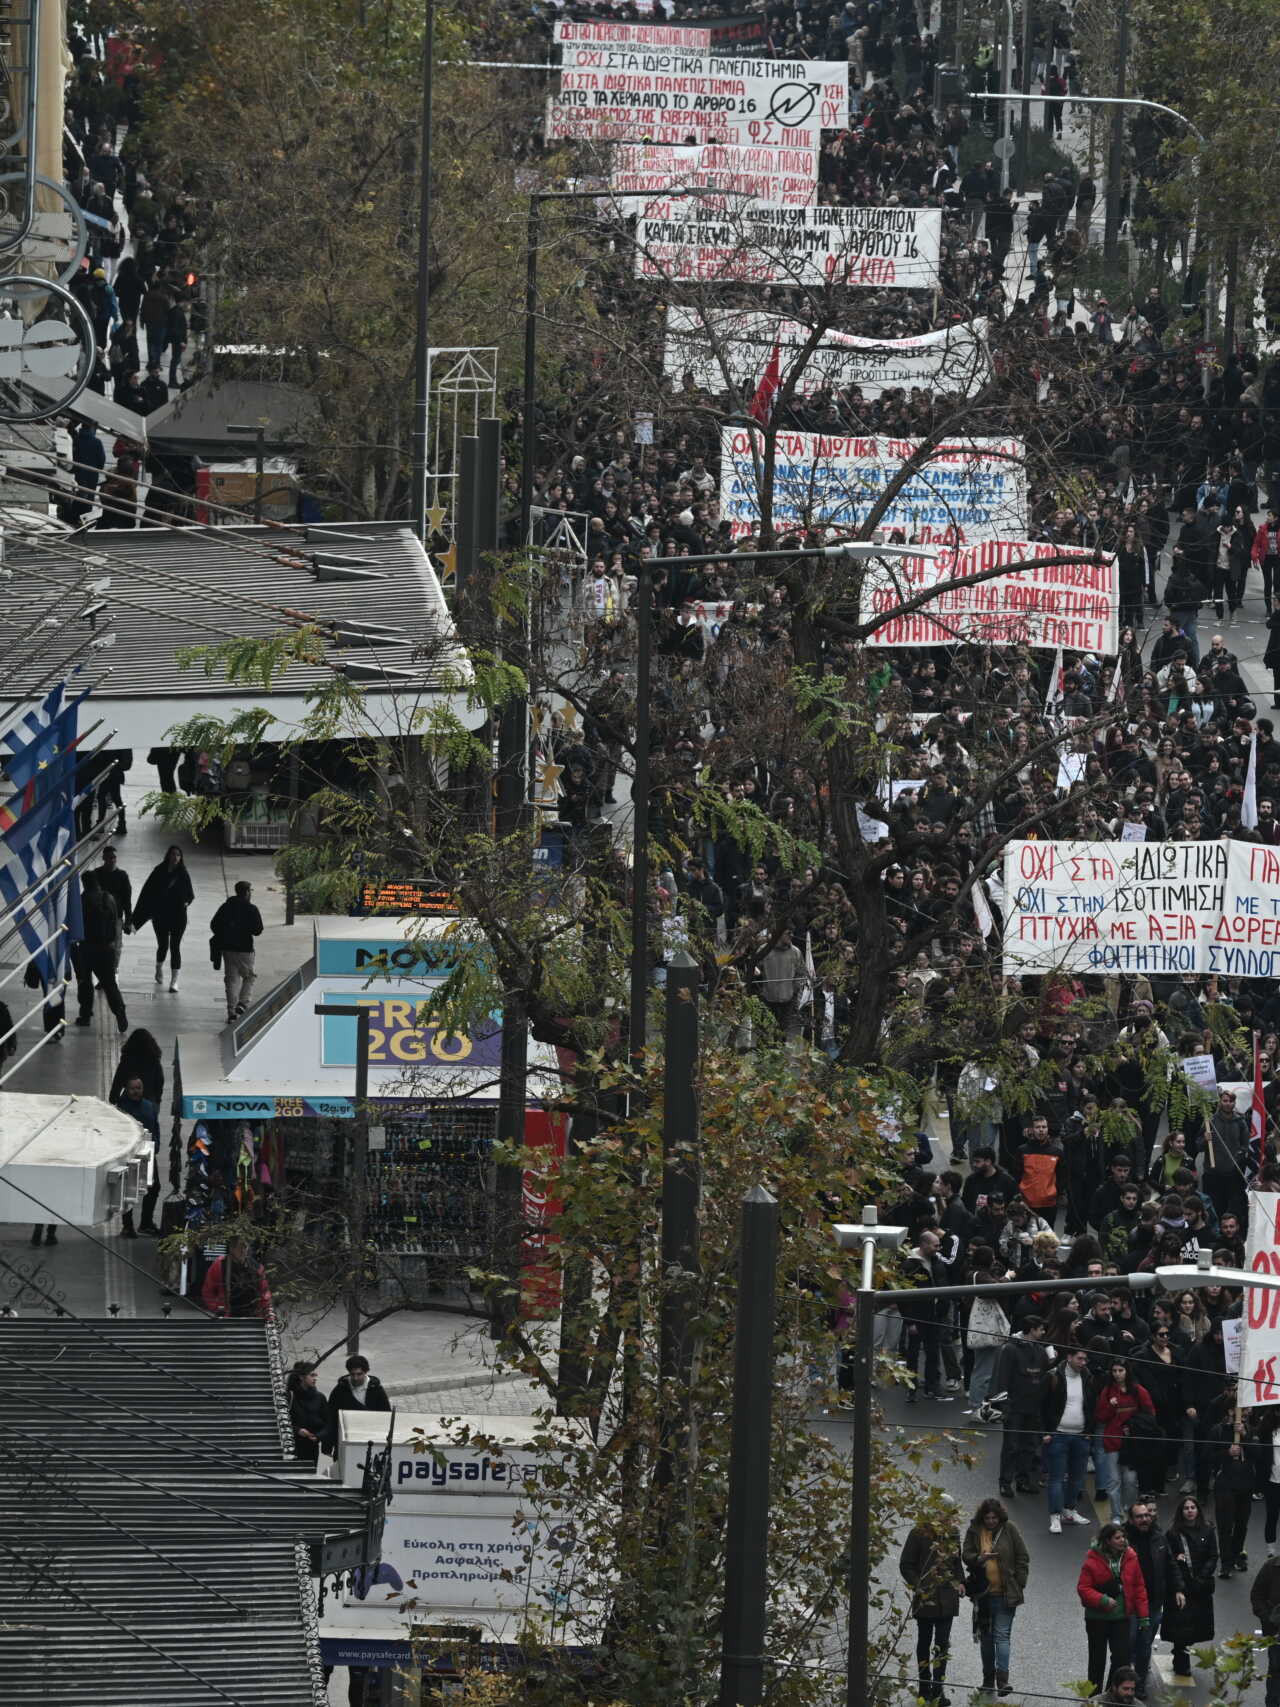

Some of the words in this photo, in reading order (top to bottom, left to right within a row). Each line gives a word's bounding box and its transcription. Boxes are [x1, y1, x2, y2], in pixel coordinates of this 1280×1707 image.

[576, 51, 602, 66] ΟΧΙ
[607, 53, 638, 69] ΣΤΑ
[643, 56, 702, 73] ΙΔΙΩΤΙΚΑ
[709, 58, 806, 79] ΠΑΝΕΠΙΣΤΗΜΙΑ
[577, 74, 598, 88] ΣΤΑ
[604, 75, 651, 91] ΙΔΙΩΤΙΚΑ
[655, 77, 745, 95] ΠΑΝΕΠΙΣΤΗΜΙΑ
[593, 91, 607, 105] ΤΑ
[610, 92, 640, 106] ΧΕΡΙΑ
[641, 93, 668, 109] ΑΠΟ
[673, 94, 688, 109] ΤΟ
[693, 95, 735, 111] ΑΡΘΡΟ
[738, 99, 756, 113] 16
[904, 235, 919, 259] 16
[1004, 585, 1109, 621] ΠΑΝΕΠΙΣΤΗΜΙΑ
[1020, 845, 1054, 881] ΟΧΙ
[1070, 858, 1114, 881] ΣΤΑ
[1134, 844, 1228, 880] ΙΔΙΩΤΙΚΑ
[1019, 887, 1045, 913] ΟΧΙ
[1057, 895, 1104, 913] ΣΤΗΝ
[1115, 884, 1224, 912] ΙΣΟΤΙΜΗΣΗ
[1236, 895, 1260, 914] ΜΕ
[1019, 915, 1099, 941] ΠΤΥΧΙΑ
[1111, 922, 1136, 941] ΜΕ
[1089, 944, 1195, 971] ΦΟΙΤΗΤΙΚΟΙ
[216, 1101, 271, 1112] NOVA
[273, 1097, 304, 1108] FREE
[274, 1106, 304, 1118] 2GO
[396, 1457, 563, 1486] paysafeca
[403, 1538, 455, 1553] Εύκολη
[458, 1541, 484, 1552] στη
[435, 1555, 504, 1567] Ασφαλής.
